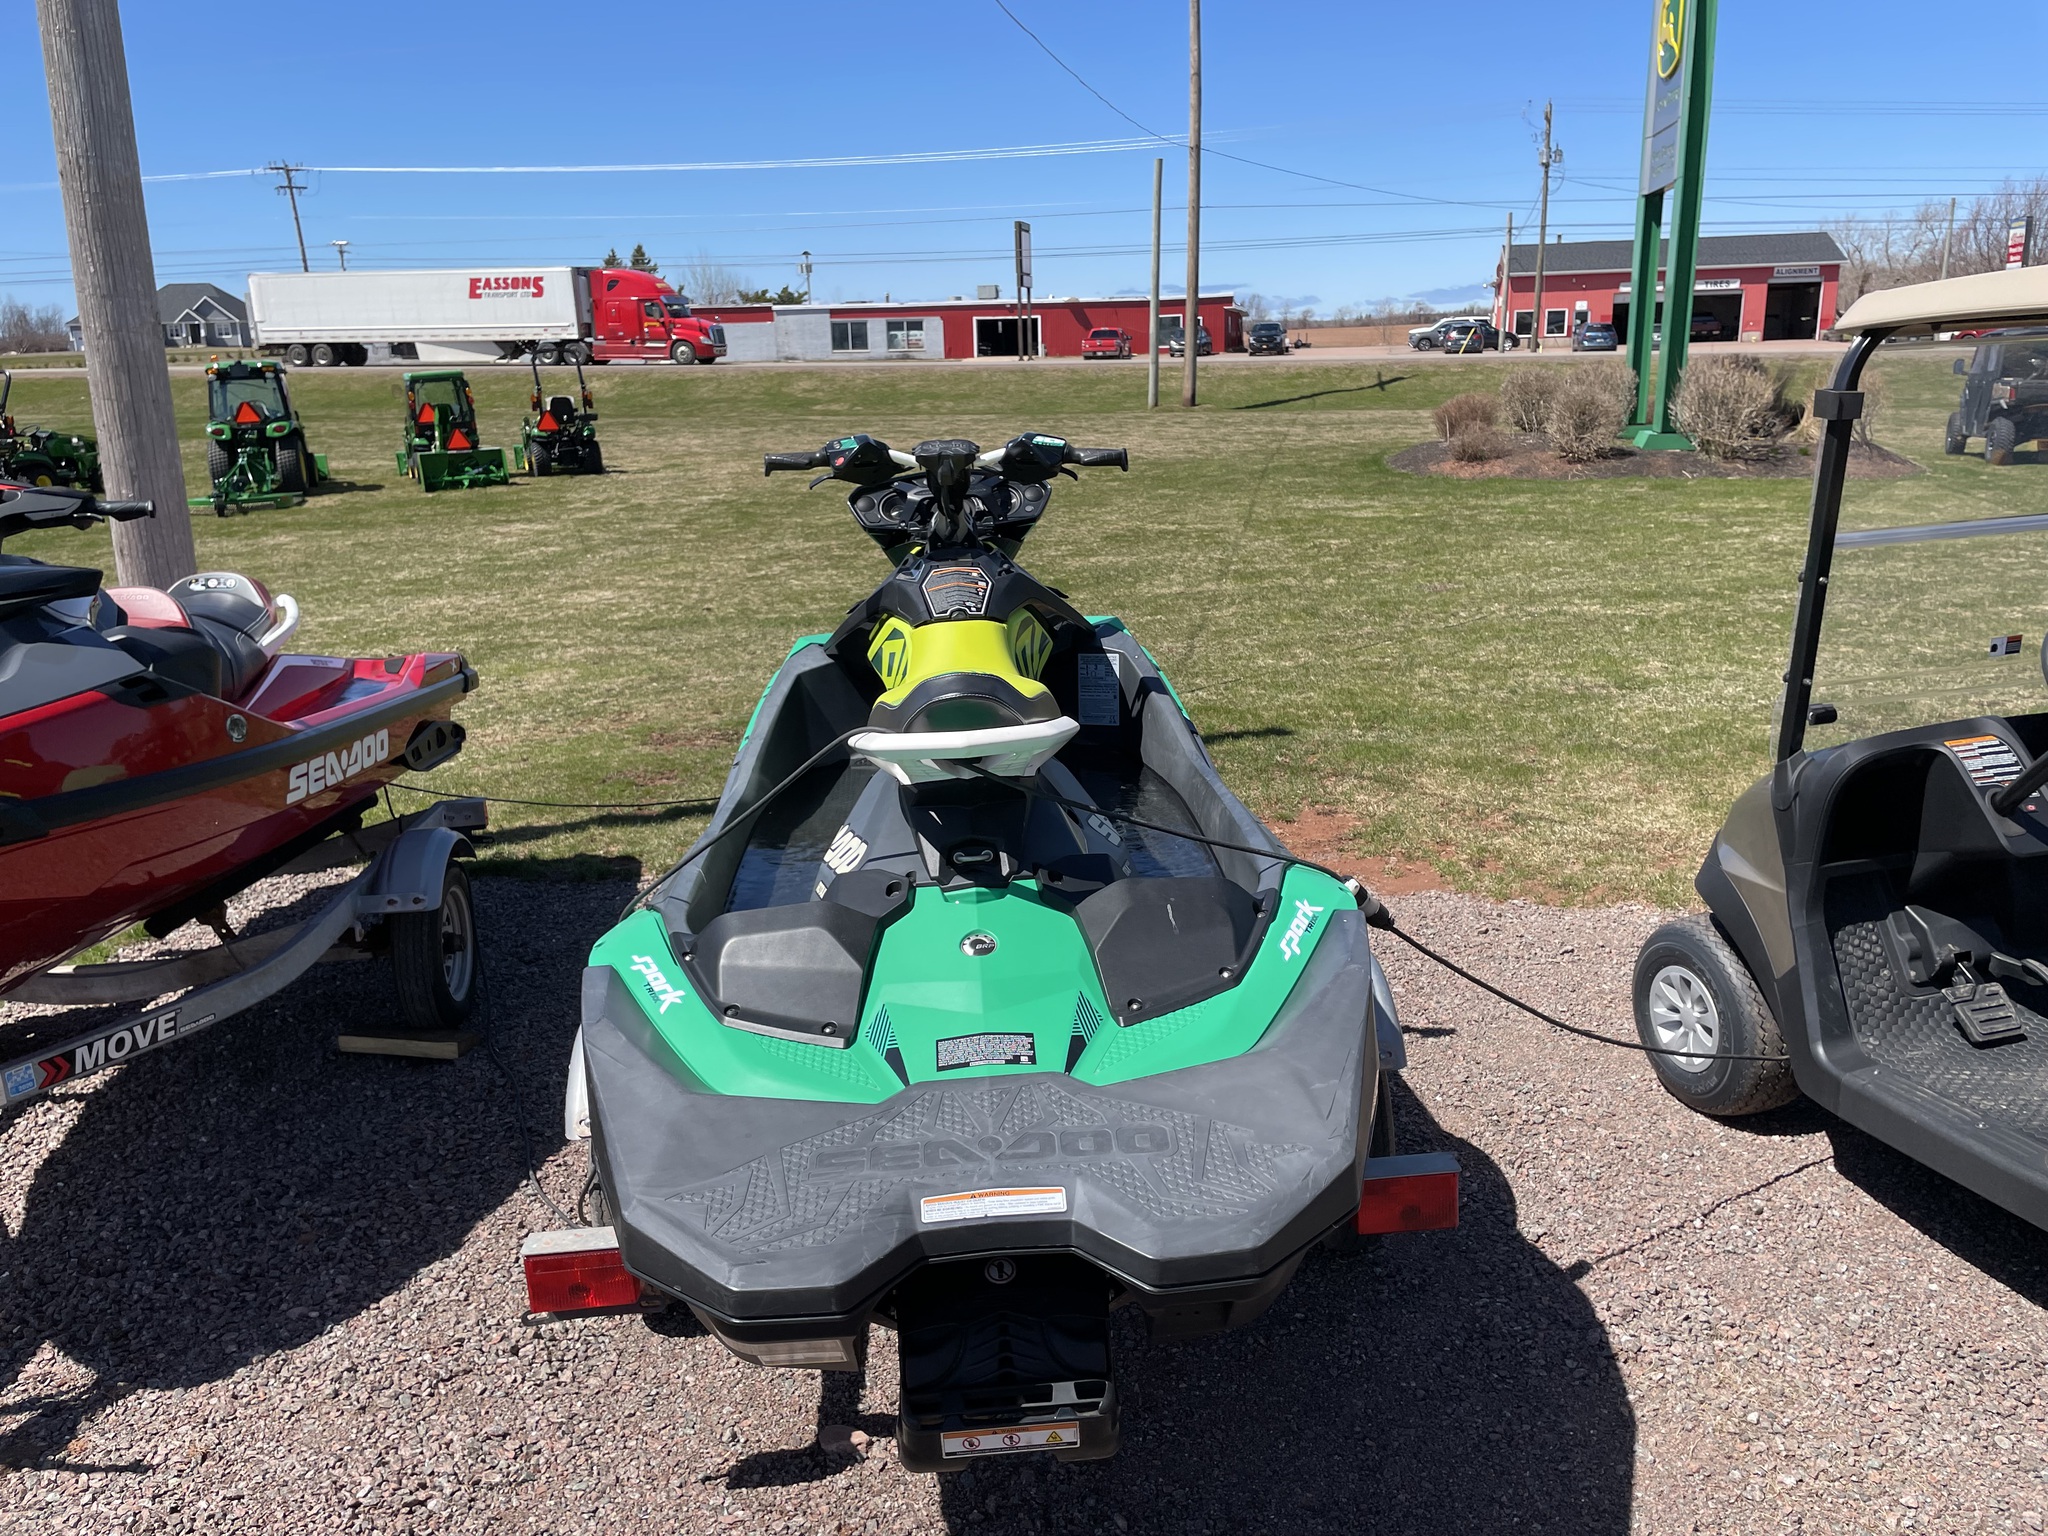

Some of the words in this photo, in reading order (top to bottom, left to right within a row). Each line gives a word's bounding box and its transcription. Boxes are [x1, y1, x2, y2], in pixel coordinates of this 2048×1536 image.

[1775, 267, 1819, 276] ALIGNMENT
[469, 276, 544, 299] EASSONS
[1704, 279, 1731, 289] TIRES
[75, 1011, 176, 1074] MOVE
[977, 1190, 1011, 1199] WARNING
